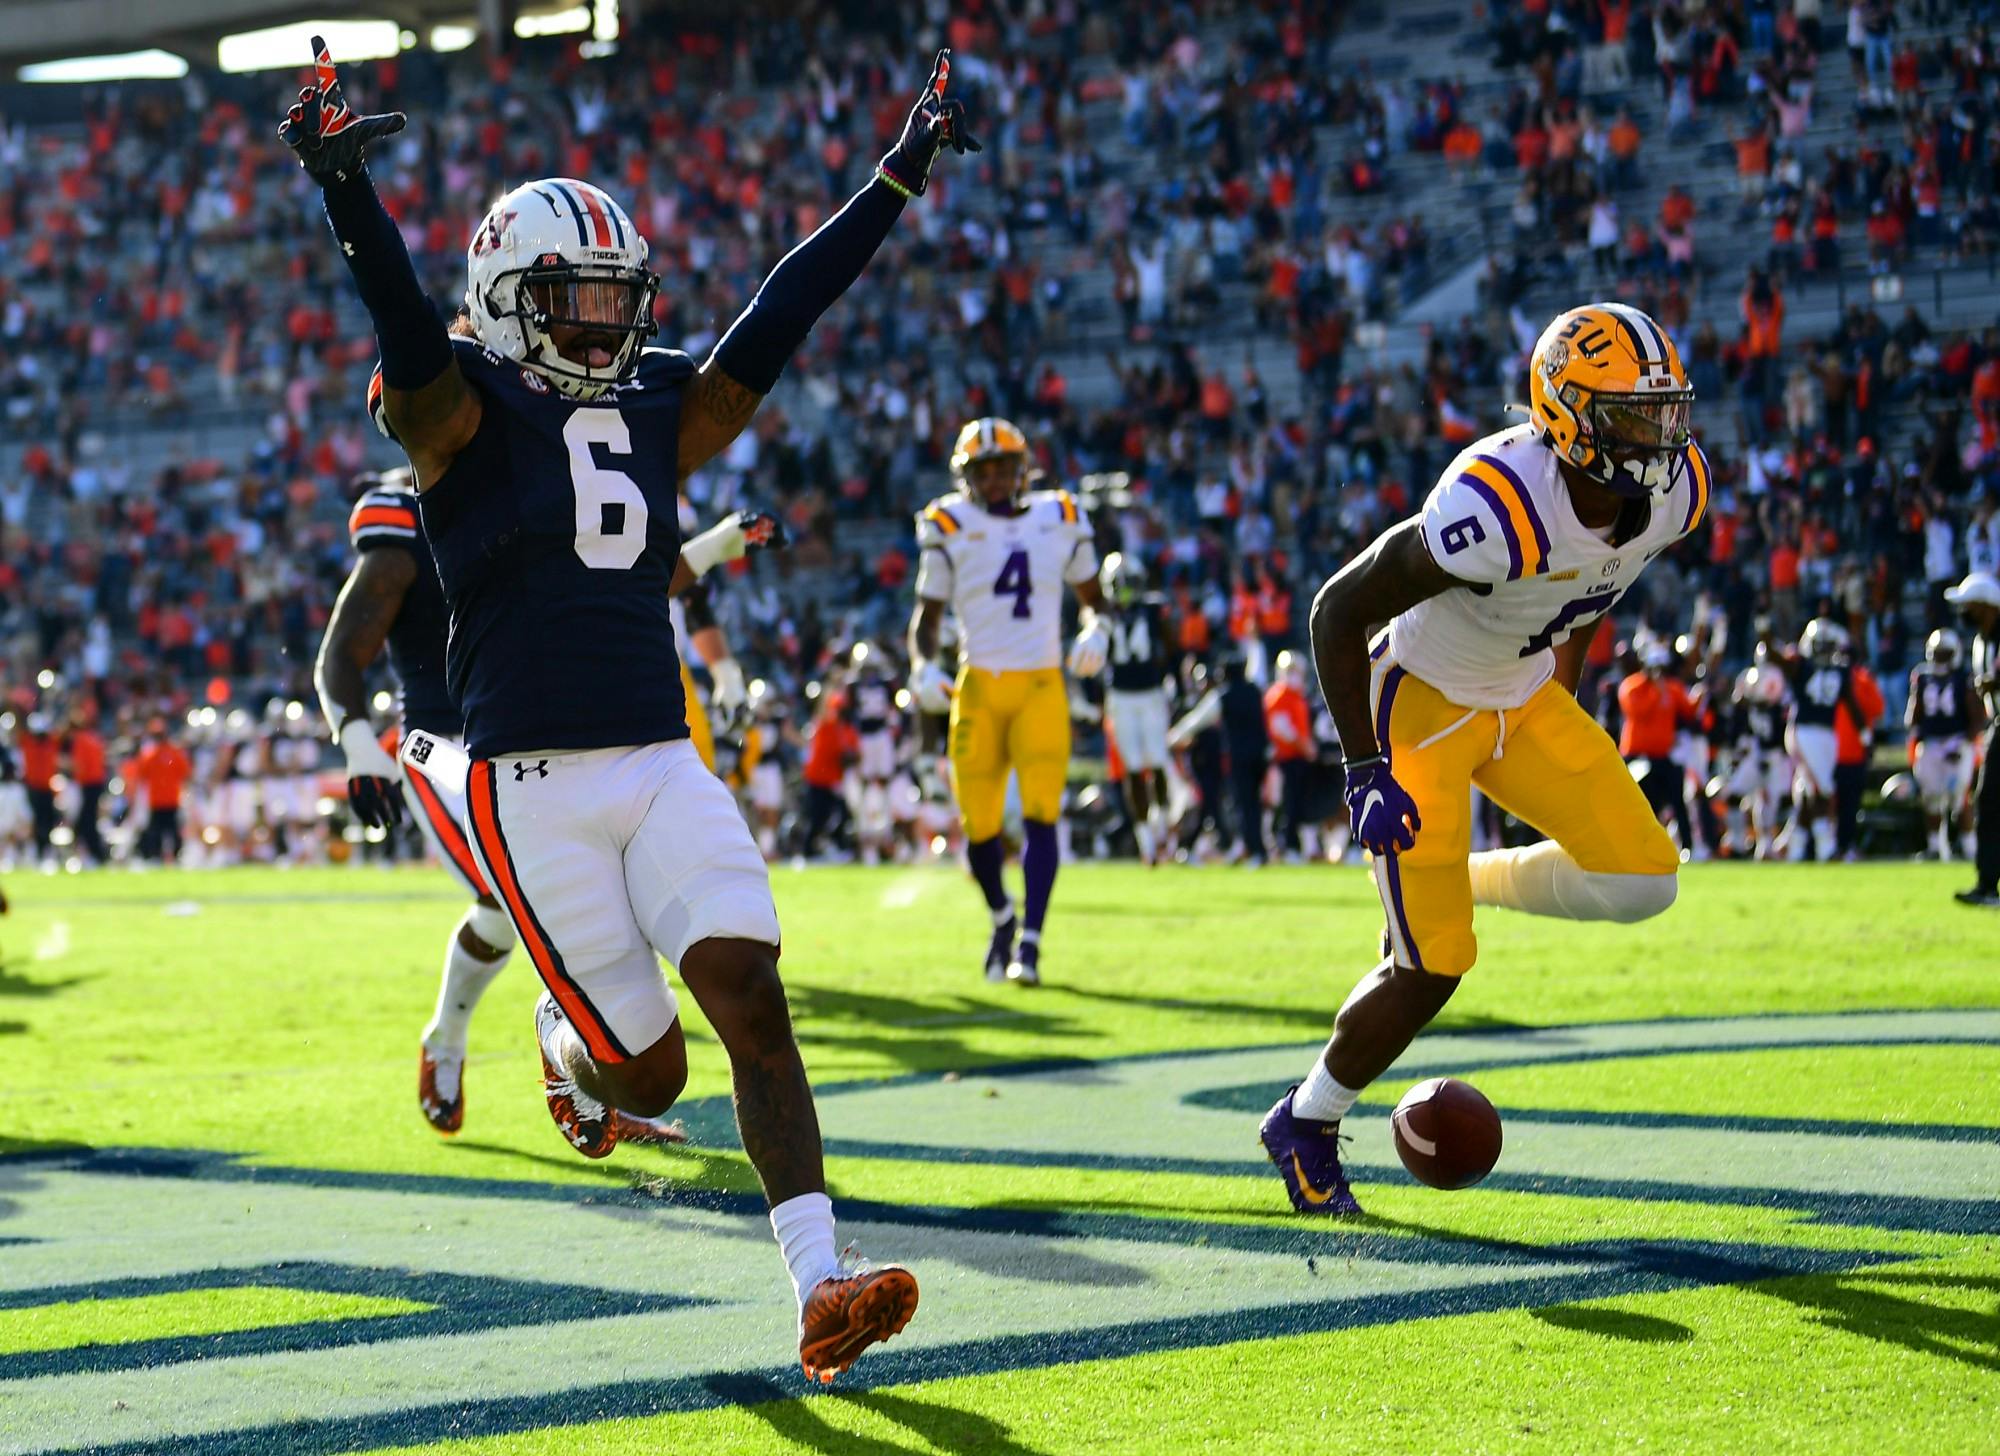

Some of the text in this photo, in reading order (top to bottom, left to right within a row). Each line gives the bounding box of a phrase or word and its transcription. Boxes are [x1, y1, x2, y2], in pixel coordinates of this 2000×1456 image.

[592, 251, 620, 260] TIGERS
[1648, 377, 1671, 387] LSU
[562, 407, 648, 570] 6
[1440, 515, 1486, 555] 6
[994, 550, 1033, 619] 4
[1586, 581, 1615, 595] LSU
[1113, 617, 1150, 664] 14
